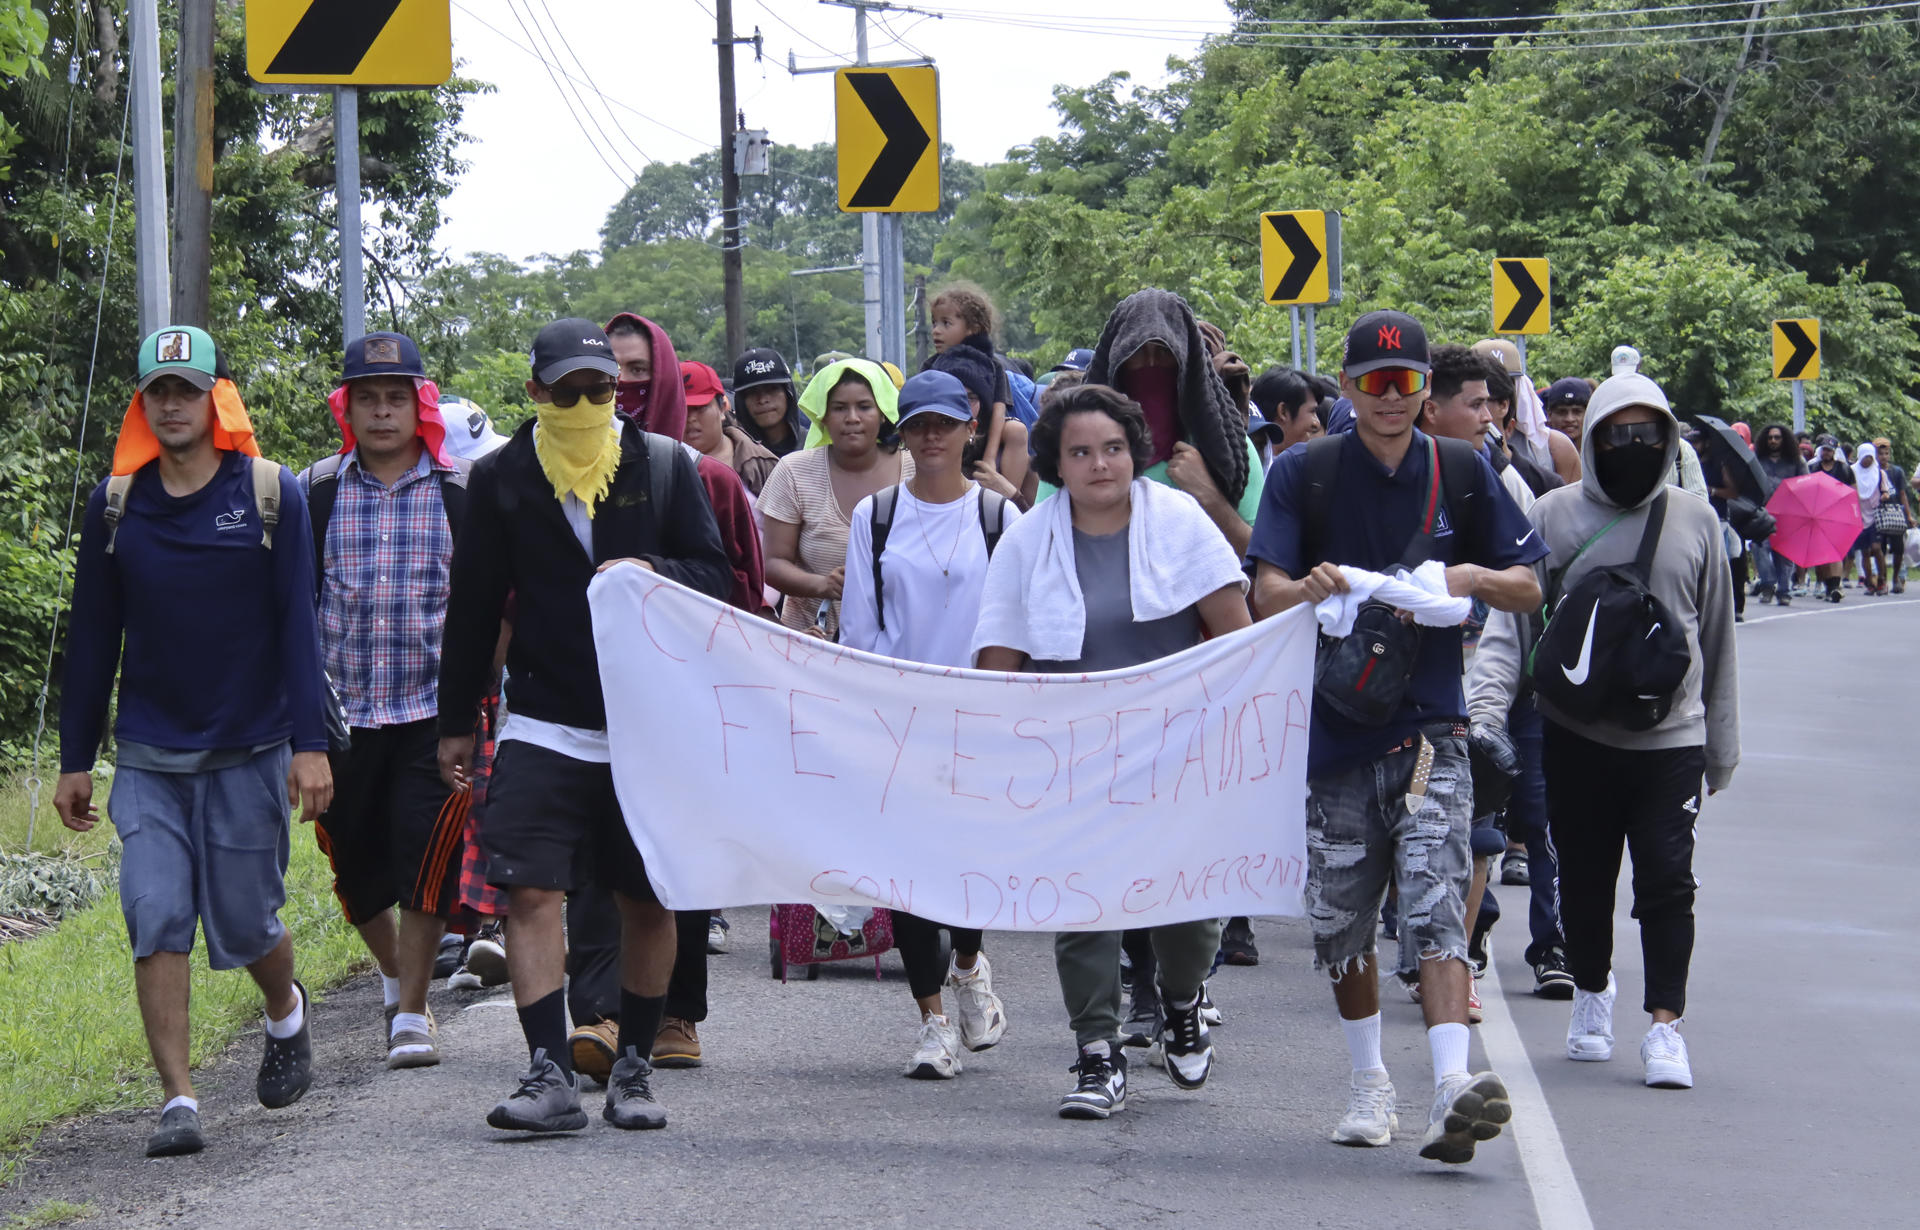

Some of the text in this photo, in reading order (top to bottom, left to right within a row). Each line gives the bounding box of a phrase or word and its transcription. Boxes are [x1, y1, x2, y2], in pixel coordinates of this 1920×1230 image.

[713, 684, 840, 778] FE
[874, 706, 917, 814] Y
[810, 869, 913, 914] CON
